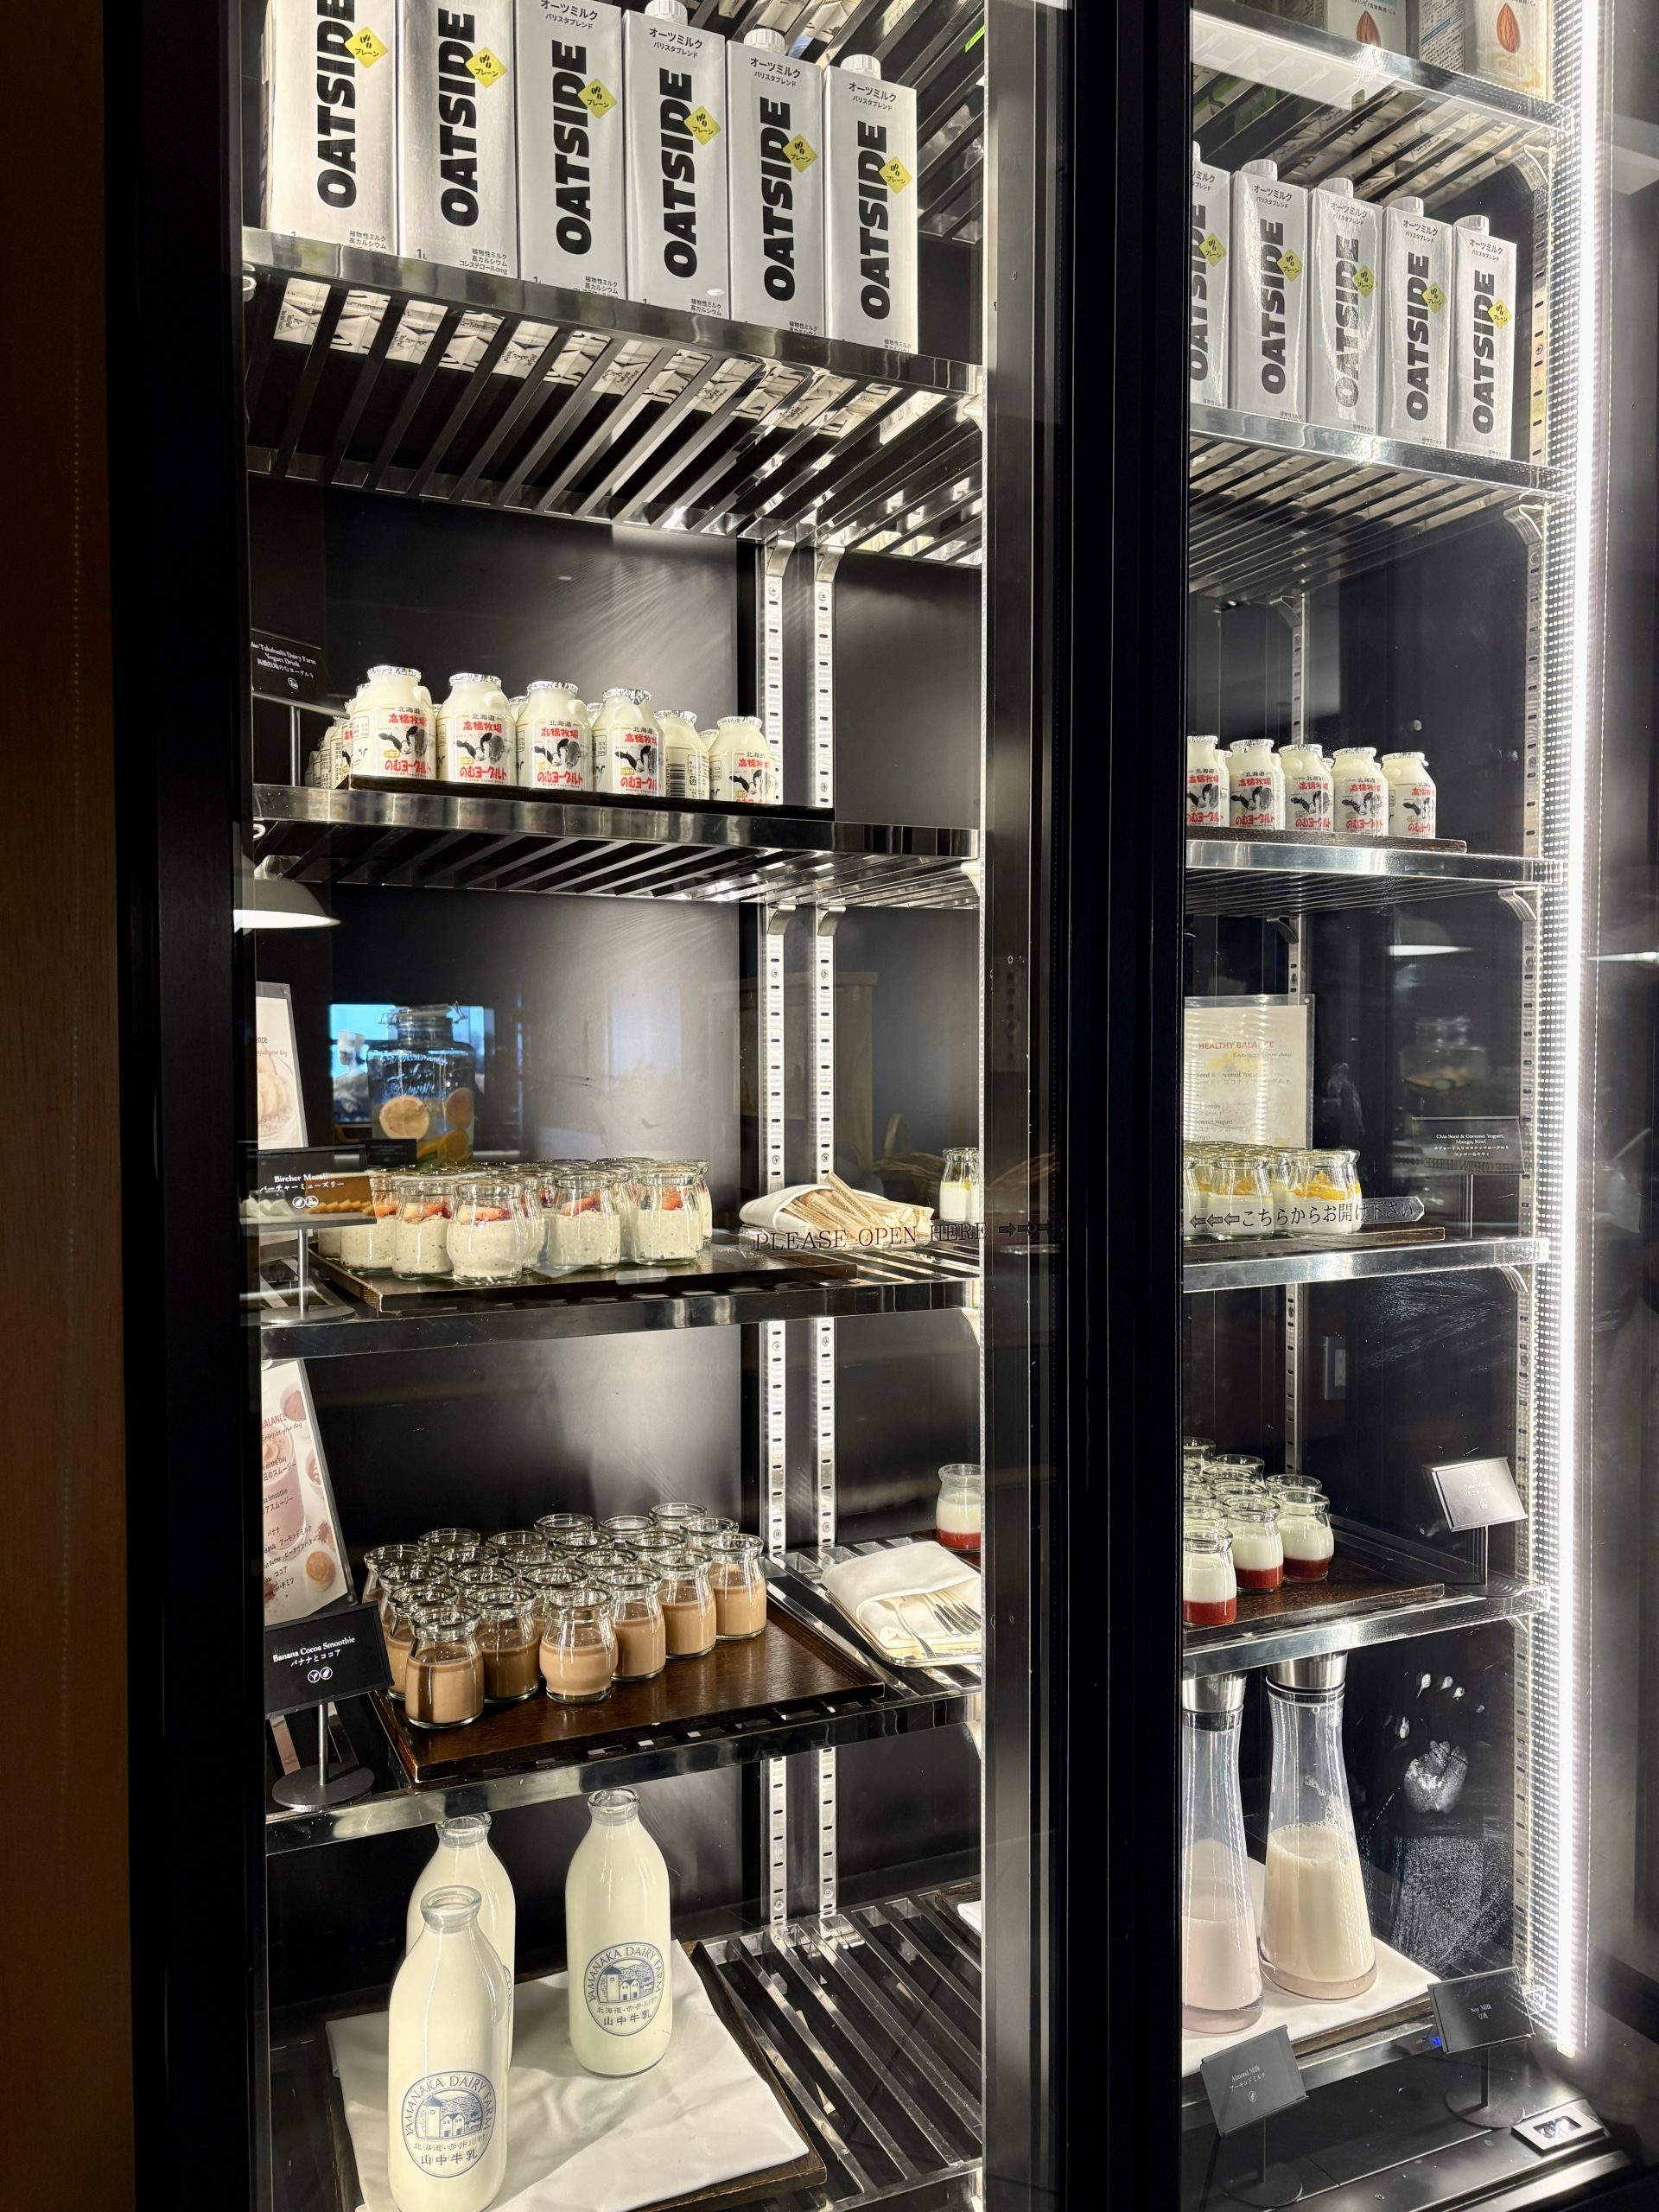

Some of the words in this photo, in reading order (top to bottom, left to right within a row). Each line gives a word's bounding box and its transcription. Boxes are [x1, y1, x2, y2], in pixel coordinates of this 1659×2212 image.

[541, 0, 598, 20] オーツミルク
[649, 28, 702, 49] オーツミルク
[750, 57, 801, 79] オーツミルク
[849, 81, 897, 103] オーツミルク
[316, 0, 357, 208] OATSIDE
[438, 8, 479, 227] OATSIDE
[551, 40, 592, 255] OATSIDE
[659, 67, 697, 278] OATSIDE
[760, 96, 796, 302] OATSIDE
[1254, 184, 1292, 201] オーツミルク
[1331, 202, 1368, 218] オーツミルク
[856, 120, 891, 320] OATSIDE
[1403, 219, 1439, 236] オーツミルク
[472, 248, 507, 260] 植物性ミルク
[1469, 238, 1503, 255] オーツミルク
[472, 255, 507, 268] 高カルシウム
[1261, 218, 1286, 394] OATSIDE
[1335, 234, 1359, 407] OATSIDE
[1406, 251, 1429, 421] OATSIDE
[1472, 270, 1495, 434] OATSIDE
[389, 714, 427, 726] 高橋牧場
[463, 721, 502, 733] 高橋牧場
[541, 728, 579, 740] 高橋牧場
[385, 760, 431, 775] のむヨーグルト
[459, 765, 507, 779] のむヨーグルト
[537, 771, 583, 785] のむヨーグルト
[1236, 813, 1274, 825] のむヨーグルト
[260, 1181, 344, 1192] バーチャーミューズリー
[274, 1174, 301, 1183] Bircher
[303, 1173, 328, 1181] Muesli
[1243, 1202, 1413, 1227] こちらからお開け下さい
[754, 1230, 847, 1251] PLEASE
[858, 1225, 917, 1247] OPEN
[930, 1222, 988, 1243] HERE
[275, 1566, 287, 1577] ココア
[272, 1650, 299, 1662] Banana
[300, 1645, 321, 1656] Cocoa
[322, 1636, 355, 1649] Smoothie
[290, 1649, 340, 1667] バナナとココア
[588, 1949, 621, 2003] YAMANAKA
[626, 1947, 657, 1960] DAIRY
[654, 1959, 664, 1993] FARM
[604, 2010, 652, 2025] 山中牛乳
[404, 2078, 444, 2137] YAMANAKA
[449, 2075, 486, 2093] DAIRY
[482, 2091, 493, 2130] FARM
[421, 2149, 478, 2165] 山中牛乳
